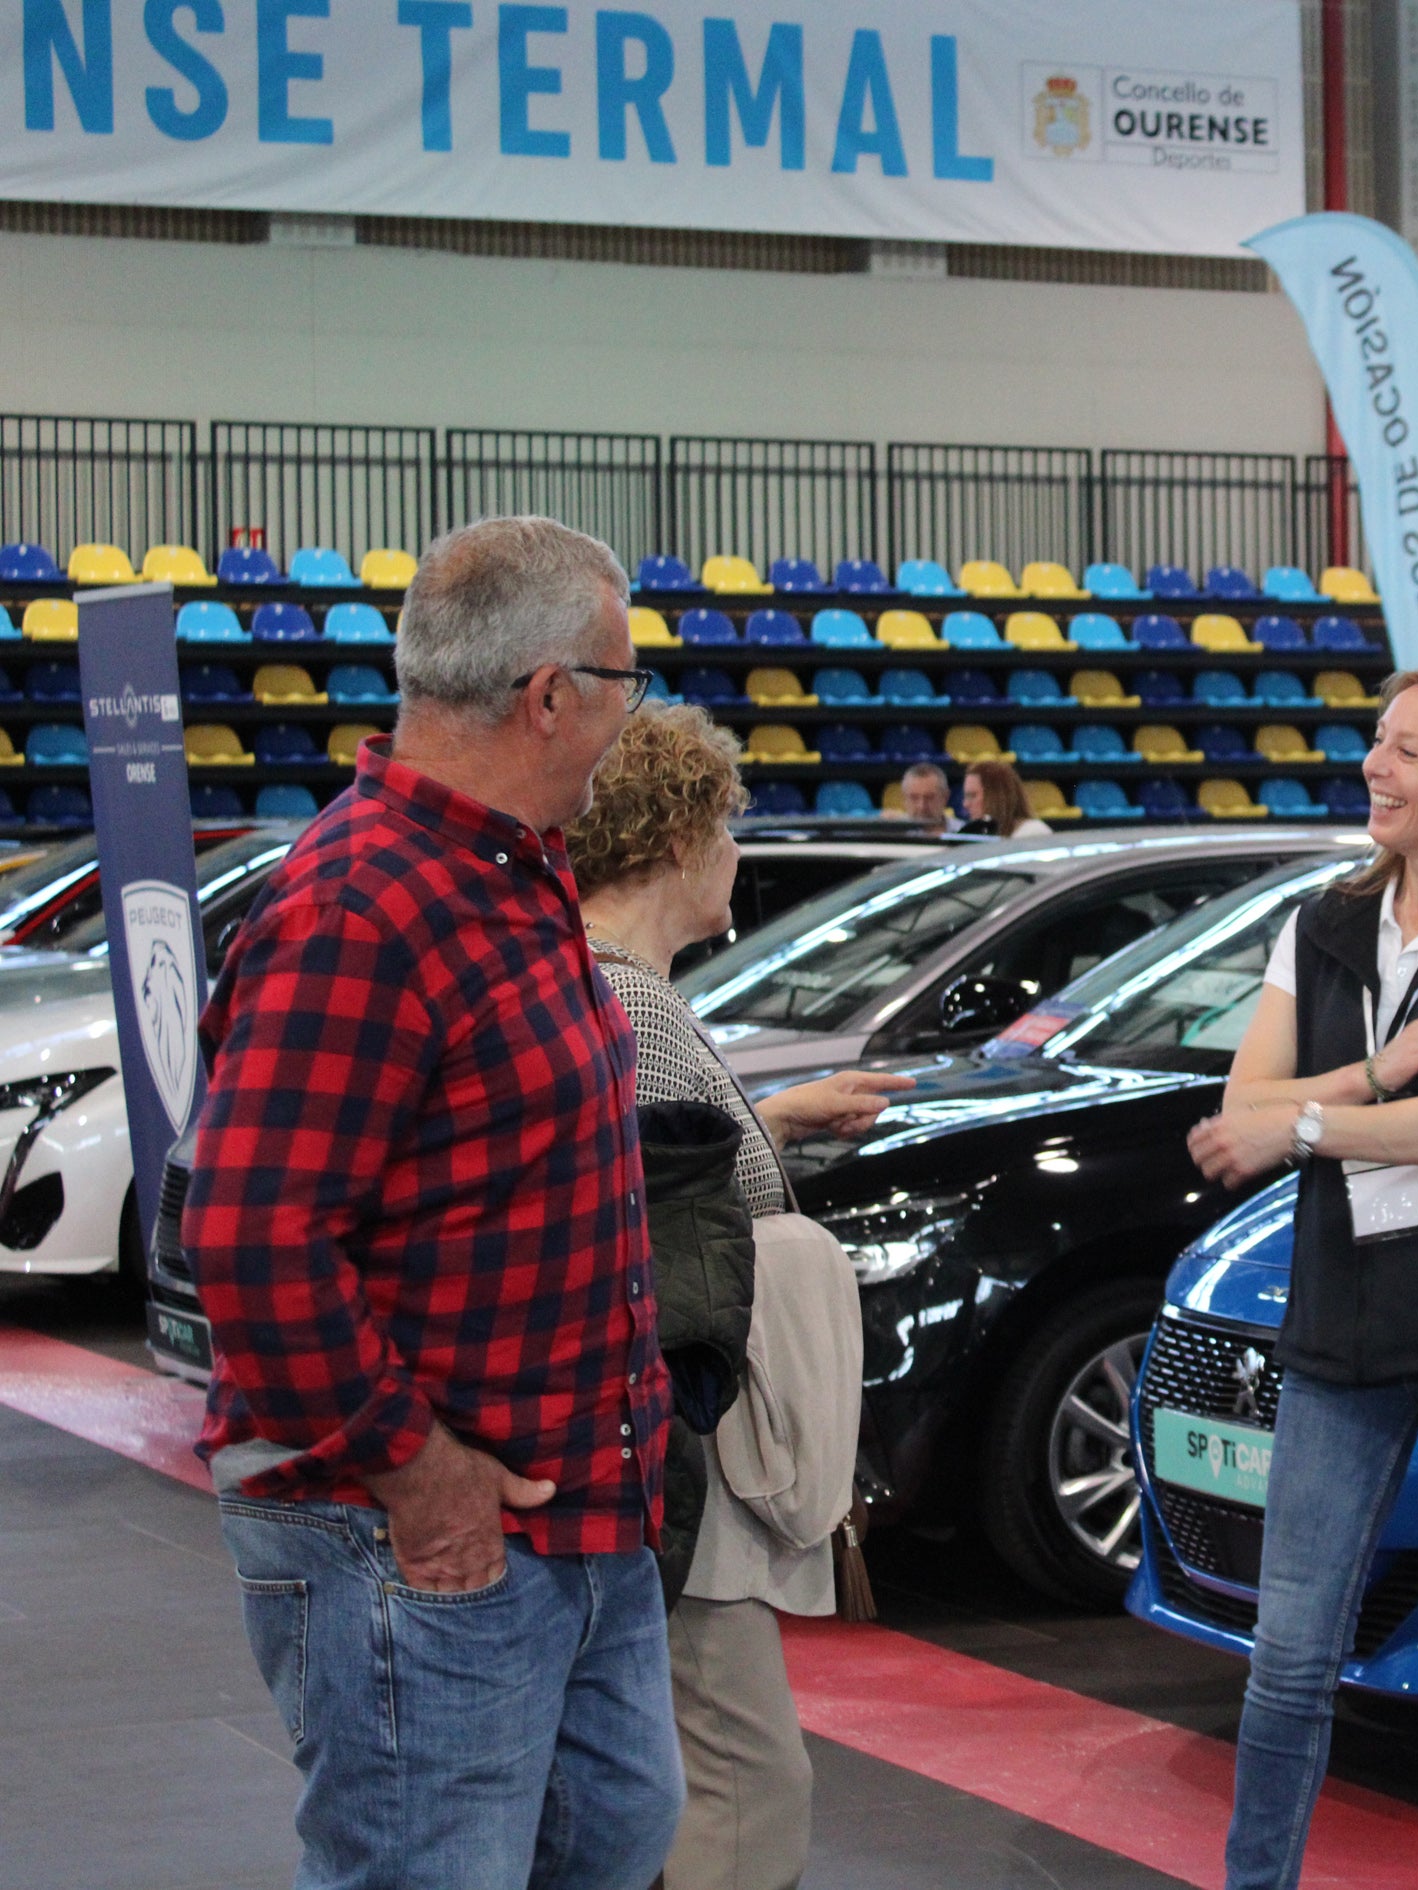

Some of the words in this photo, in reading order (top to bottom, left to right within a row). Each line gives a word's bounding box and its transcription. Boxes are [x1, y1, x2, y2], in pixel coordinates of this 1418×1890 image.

[398, 1, 994, 183] TERMAL
[1113, 74, 1212, 106] Concello
[1218, 84, 1245, 107] de
[1113, 108, 1269, 145] OURENSE
[129, 905, 182, 931] PEUGEOT
